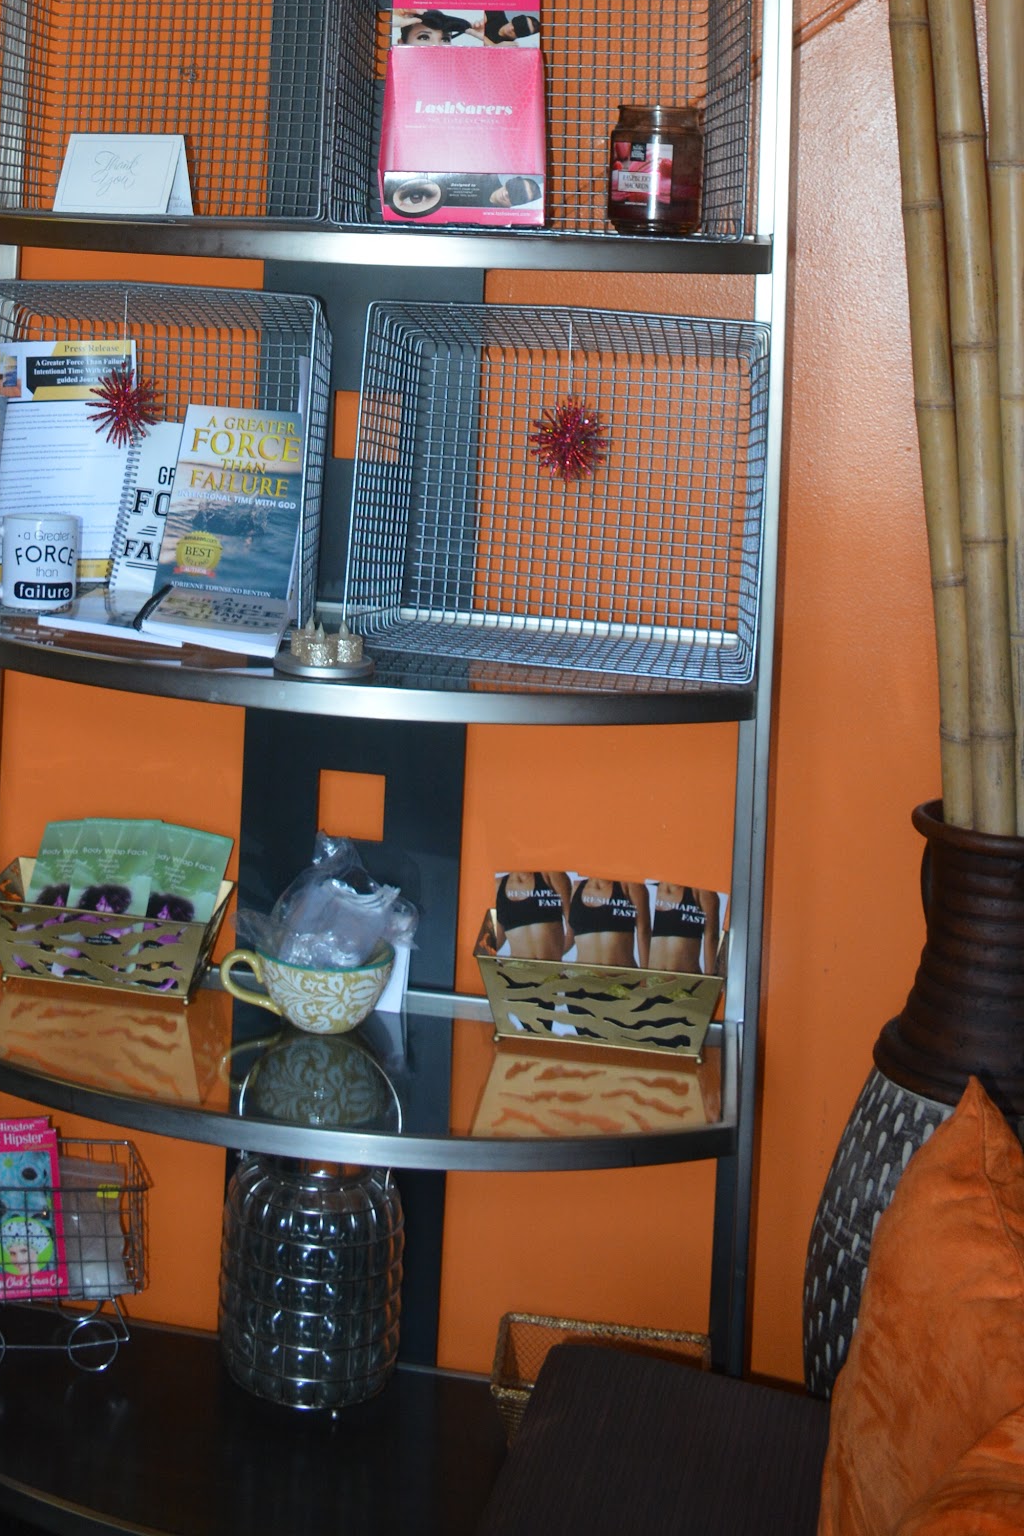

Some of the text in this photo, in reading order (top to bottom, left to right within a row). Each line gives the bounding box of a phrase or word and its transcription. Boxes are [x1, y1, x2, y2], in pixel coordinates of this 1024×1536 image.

[415, 100, 513, 116] LashSavers
[64, 344, 120, 353] Press Release
[85, 366, 101, 374] With
[57, 376, 78, 385] guided
[207, 415, 296, 435] A GREATER
[190, 427, 302, 462] FORCE
[221, 457, 267, 474] THAN
[189, 468, 290, 498] FAILURE
[234, 495, 254, 505] TIME
[254, 498, 277, 507] WITH
[278, 500, 297, 510] GOD
[34, 529, 70, 541] Greater
[15, 545, 75, 567] FORCE
[185, 546, 214, 558] BEST
[35, 566, 59, 578] than
[19, 583, 70, 599] failure
[170, 580, 272, 598] ADRIENNE TOWNSEND BENTON
[82, 846, 102, 856] Body
[104, 847, 126, 857] Wrap
[538, 899, 563, 907] FAST
[613, 907, 638, 918] FAST
[681, 914, 707, 925] FAST
[3, 1133, 44, 1147] Hipster
